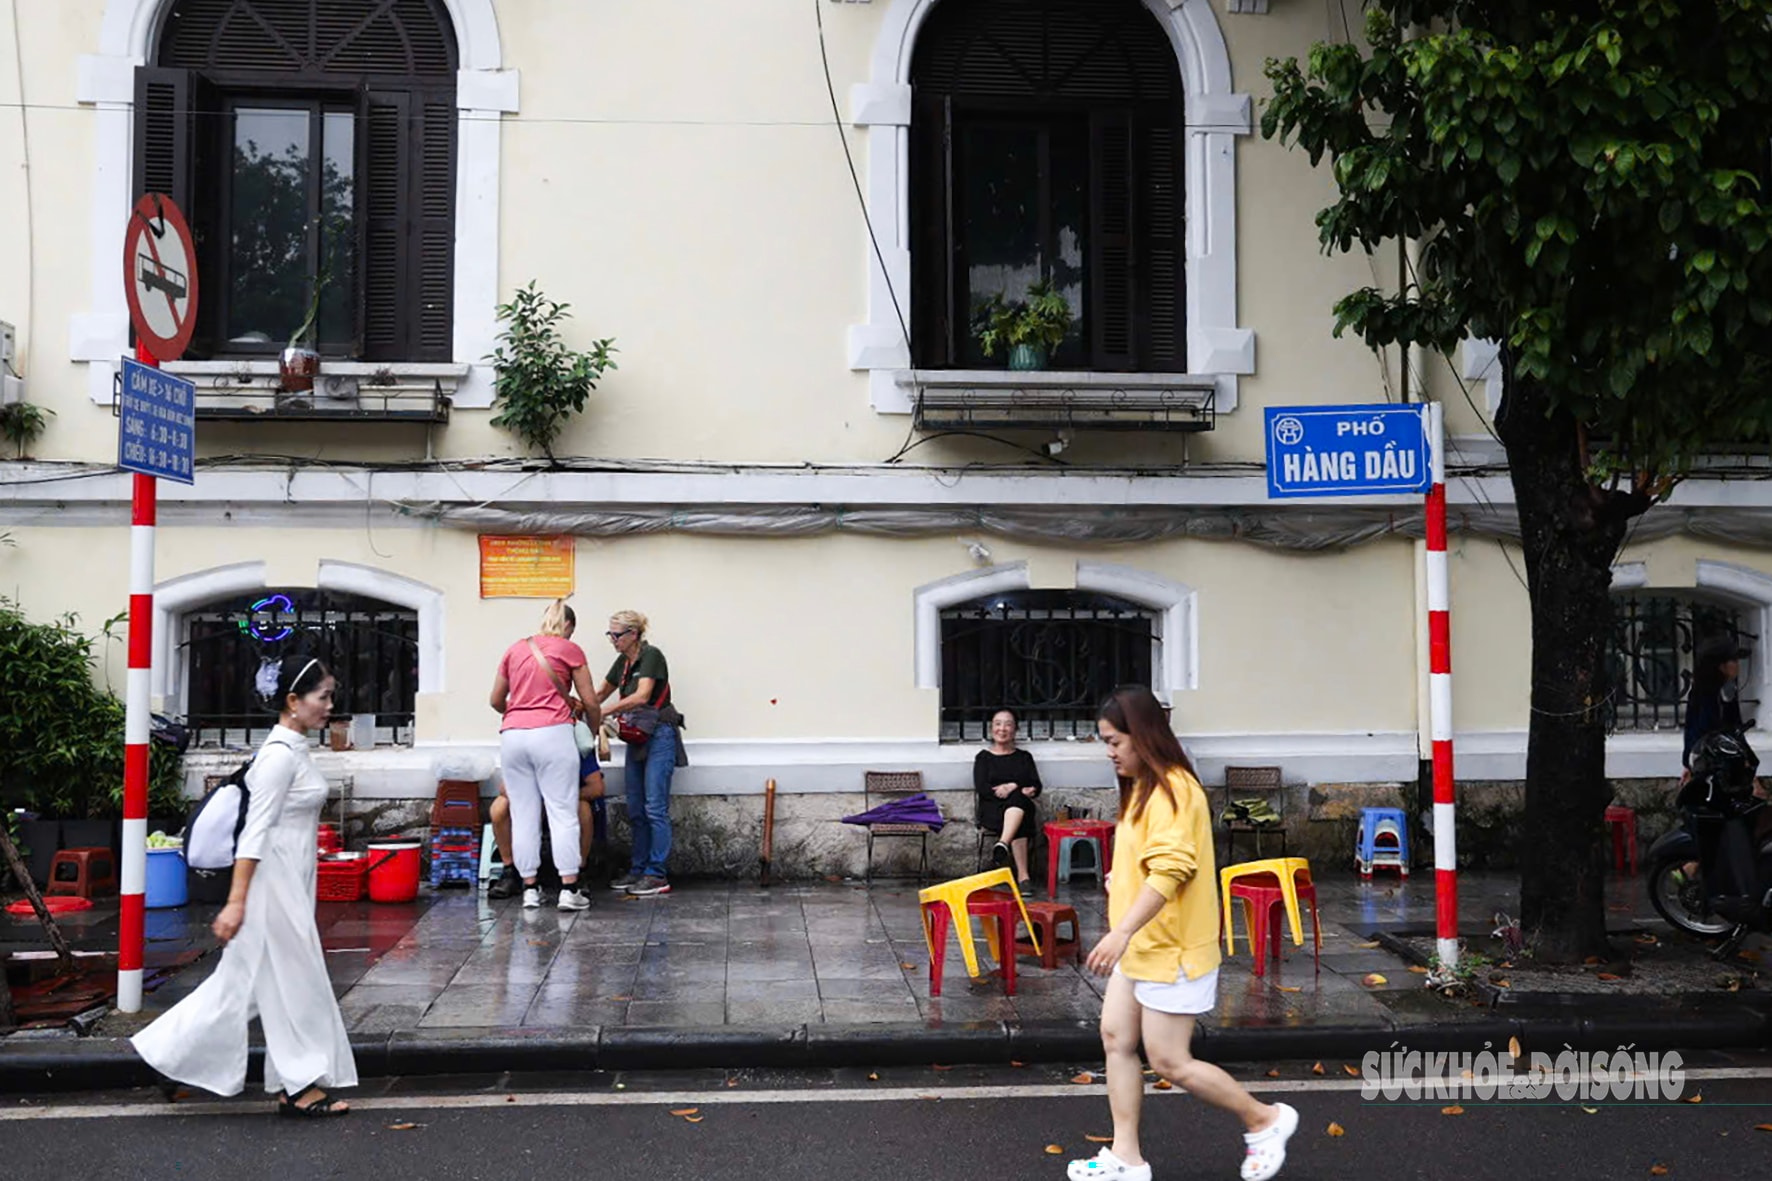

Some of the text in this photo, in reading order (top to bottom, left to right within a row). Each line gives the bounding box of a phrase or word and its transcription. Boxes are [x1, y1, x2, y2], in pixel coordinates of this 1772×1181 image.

[1337, 414, 1386, 436] PHỐ
[1284, 441, 1415, 482] HÀNG DẦU
